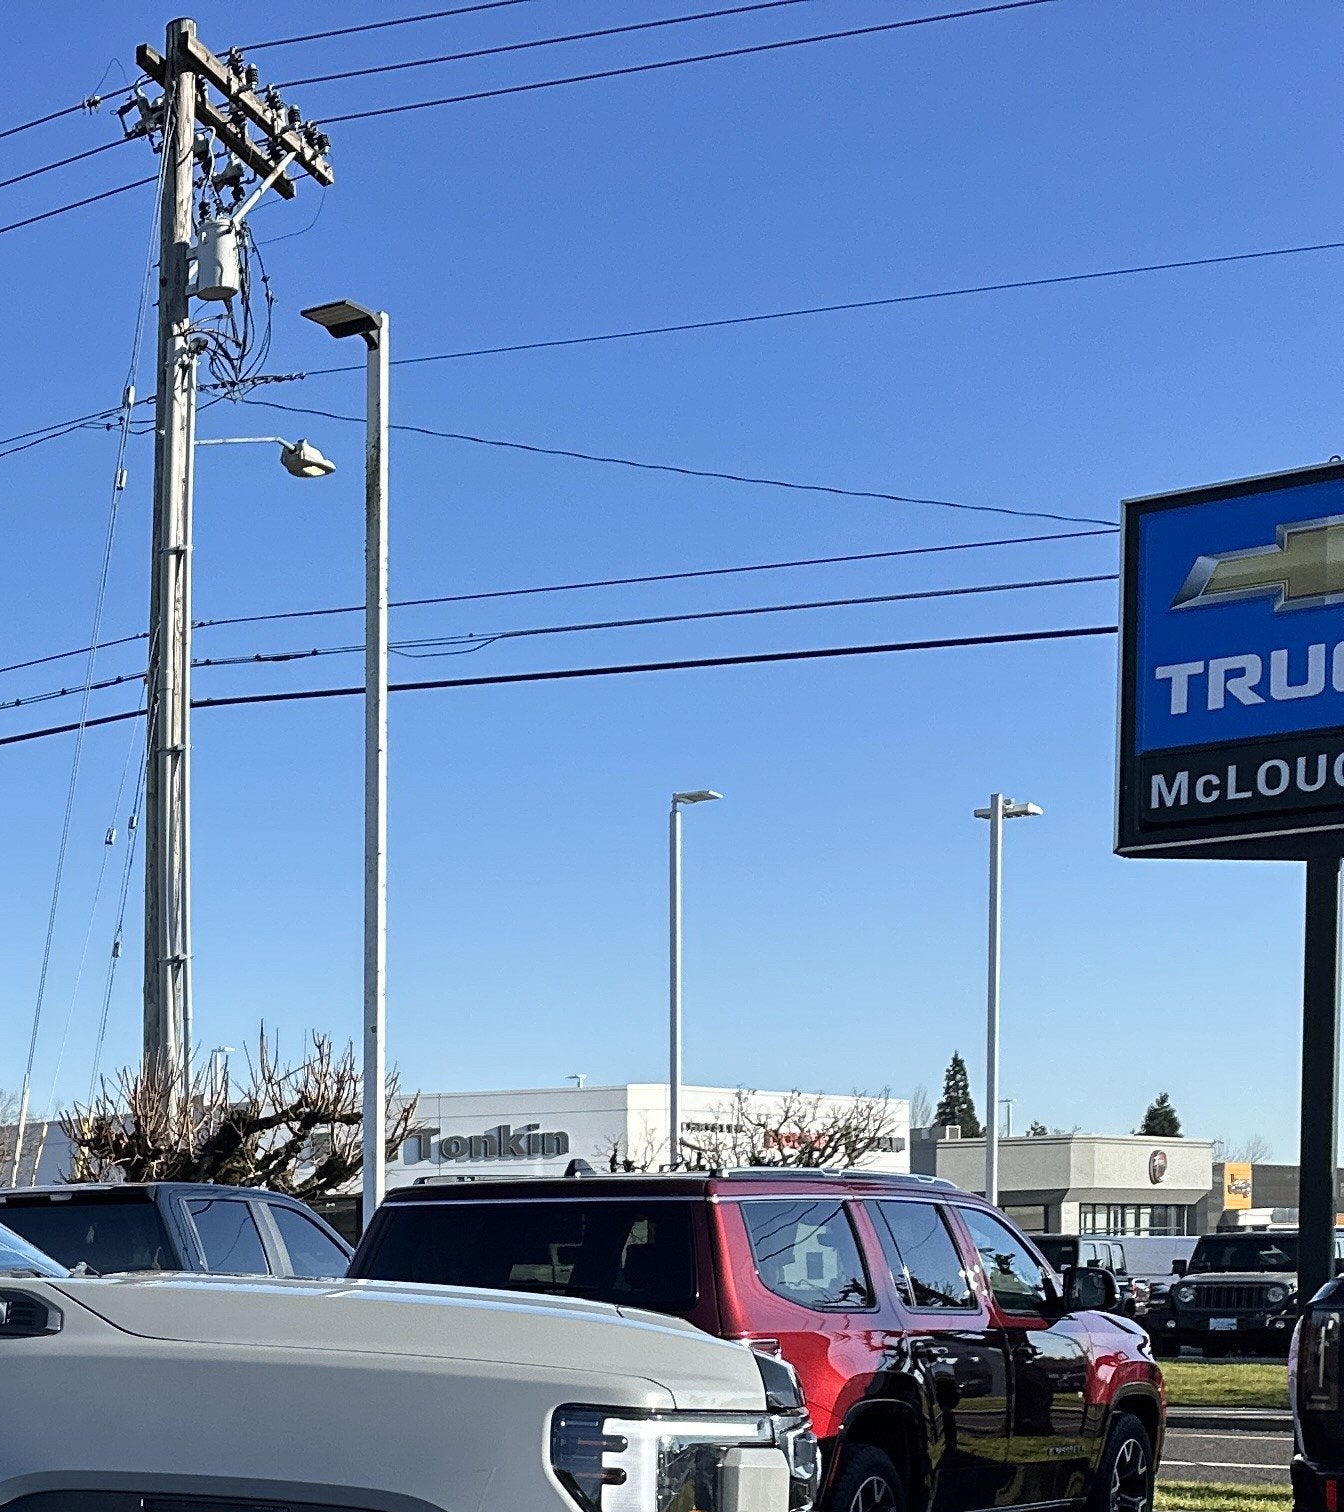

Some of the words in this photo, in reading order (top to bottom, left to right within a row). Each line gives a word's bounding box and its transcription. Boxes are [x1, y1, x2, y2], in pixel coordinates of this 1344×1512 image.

[1155, 640, 1344, 715] TRU
[1150, 753, 1344, 809] McLOU
[408, 1123, 570, 1161] Tonkin
